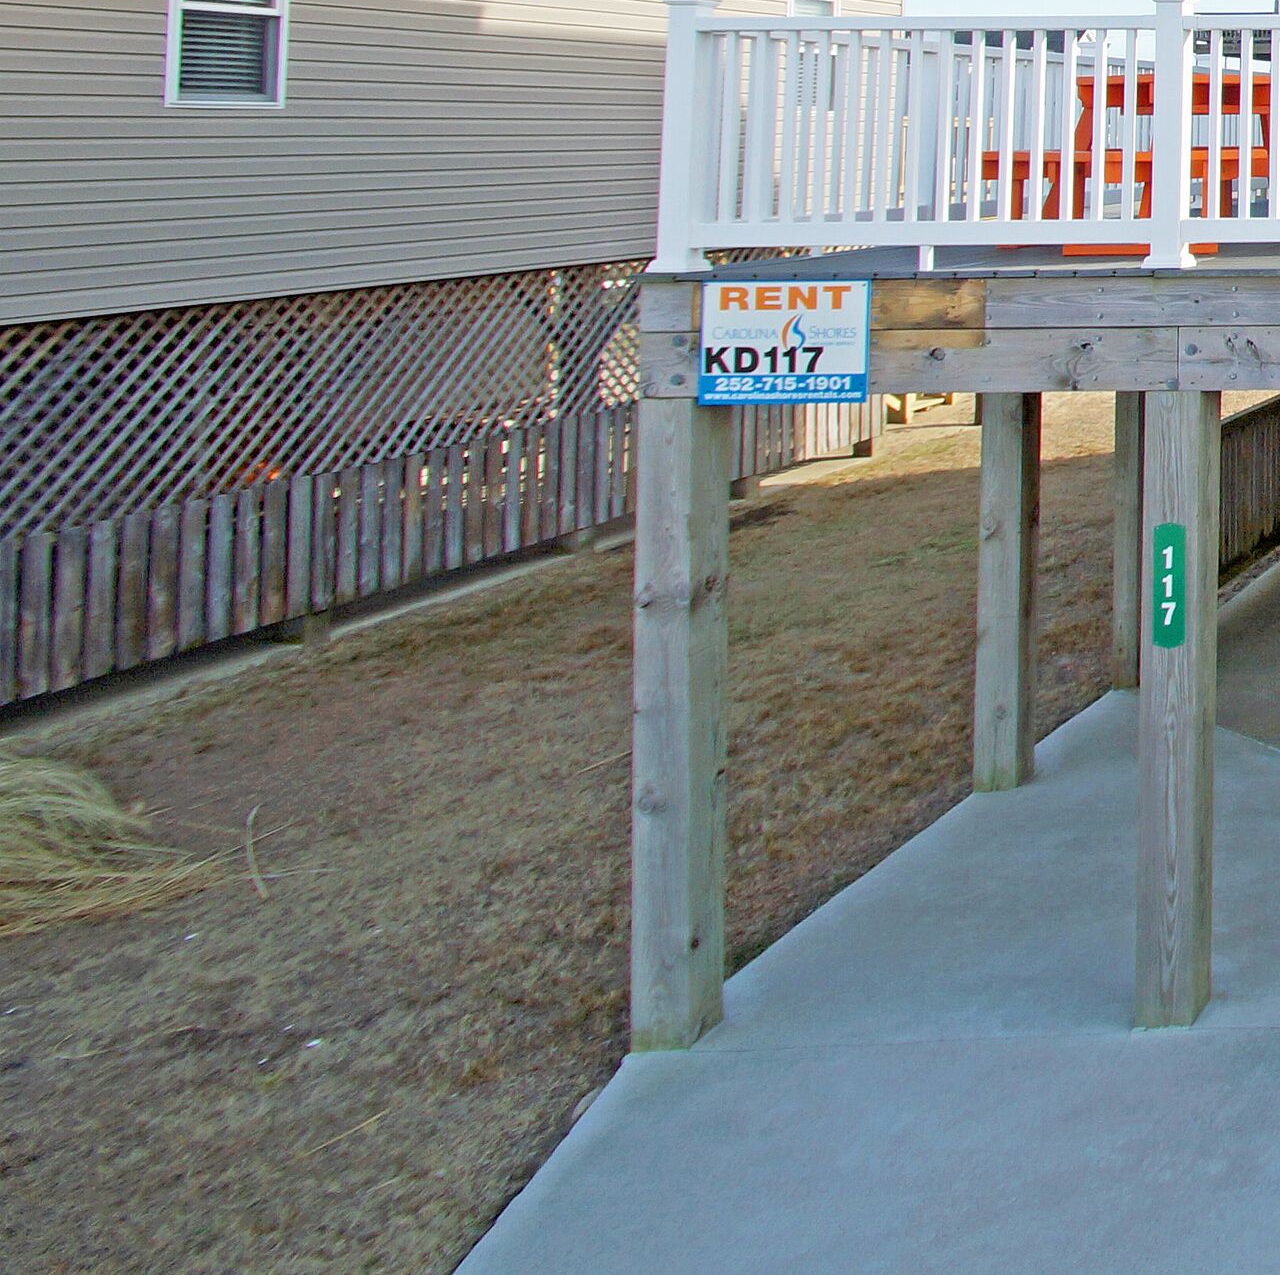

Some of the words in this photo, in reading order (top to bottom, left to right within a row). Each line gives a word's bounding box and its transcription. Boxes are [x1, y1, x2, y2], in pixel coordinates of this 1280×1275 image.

[719, 286, 852, 311] RENT
[711, 326, 779, 340] CAROLINA
[809, 325, 857, 340] SHORES
[704, 346, 825, 374] KD117
[714, 376, 852, 392] 252-715-1901
[1161, 545, 1177, 626] 117
